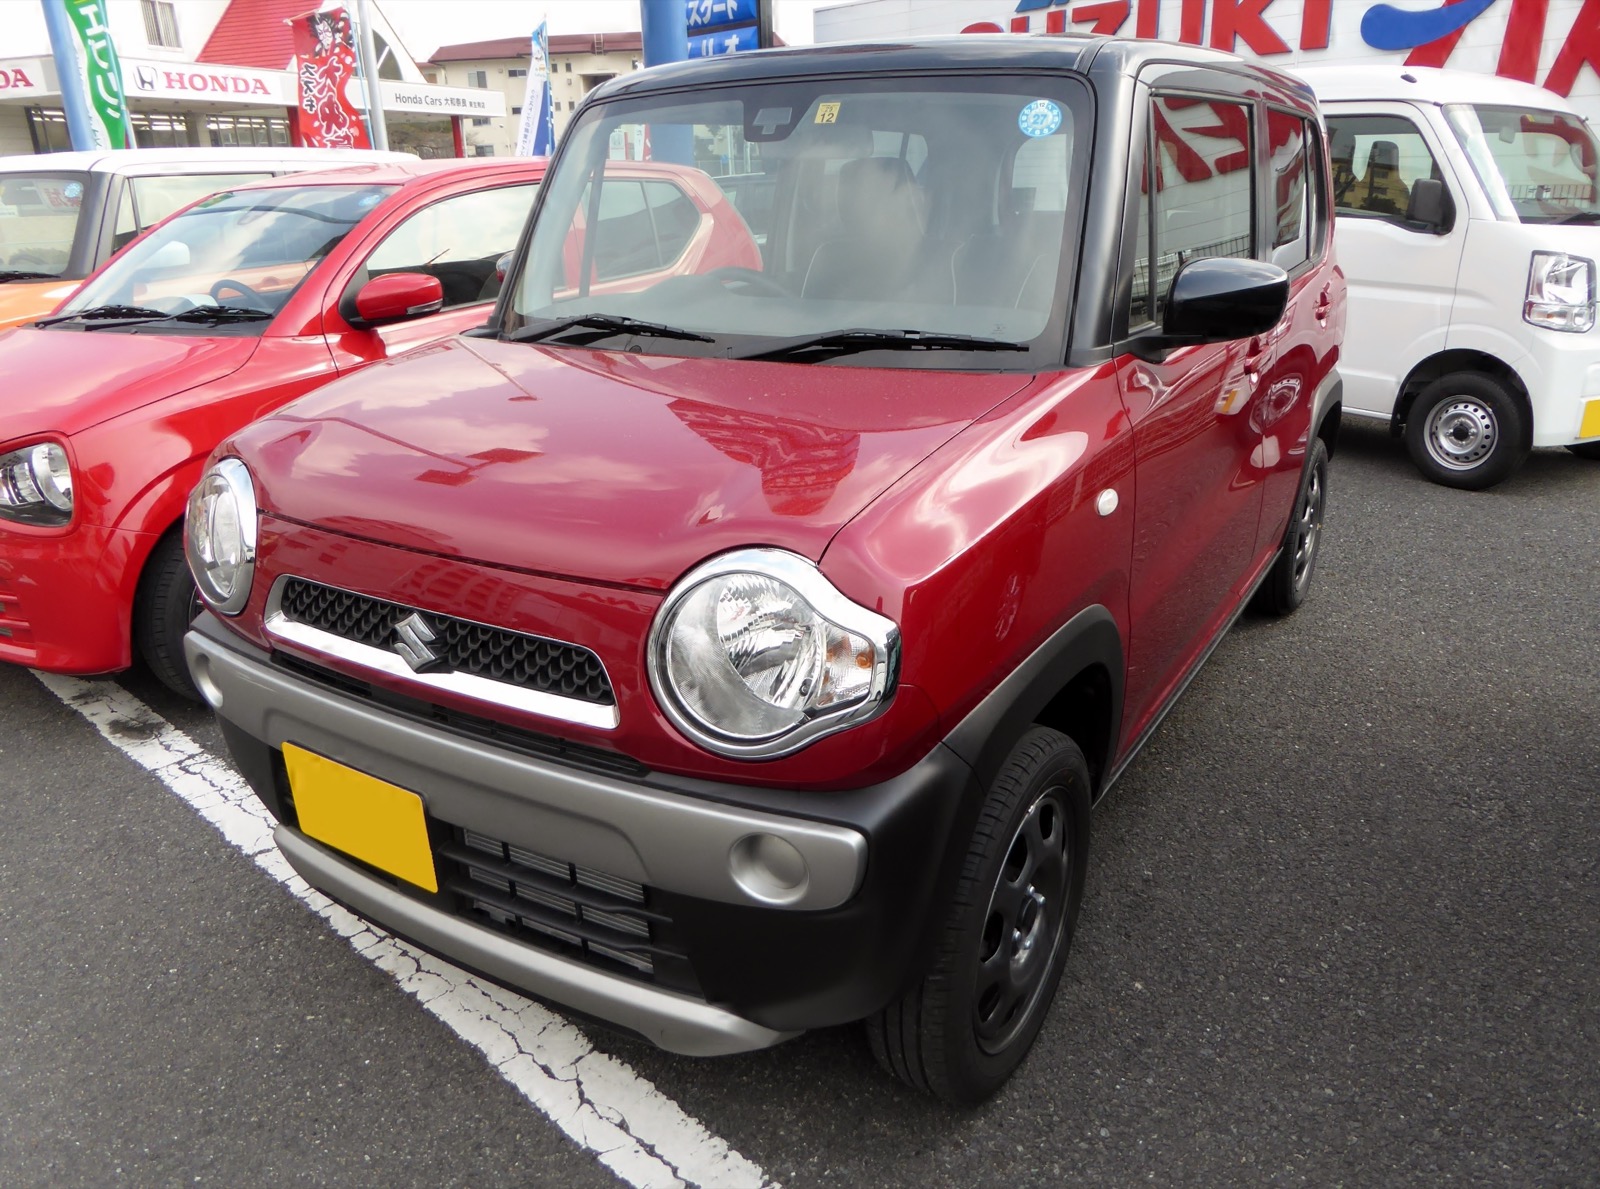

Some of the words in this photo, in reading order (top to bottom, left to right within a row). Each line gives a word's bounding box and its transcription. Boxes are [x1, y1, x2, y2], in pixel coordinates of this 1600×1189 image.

[163, 71, 271, 95] HONDA
[395, 93, 423, 105] Honda
[424, 95, 443, 106] Cars
[820, 112, 835, 123] 12
[1032, 113, 1047, 125] 27
